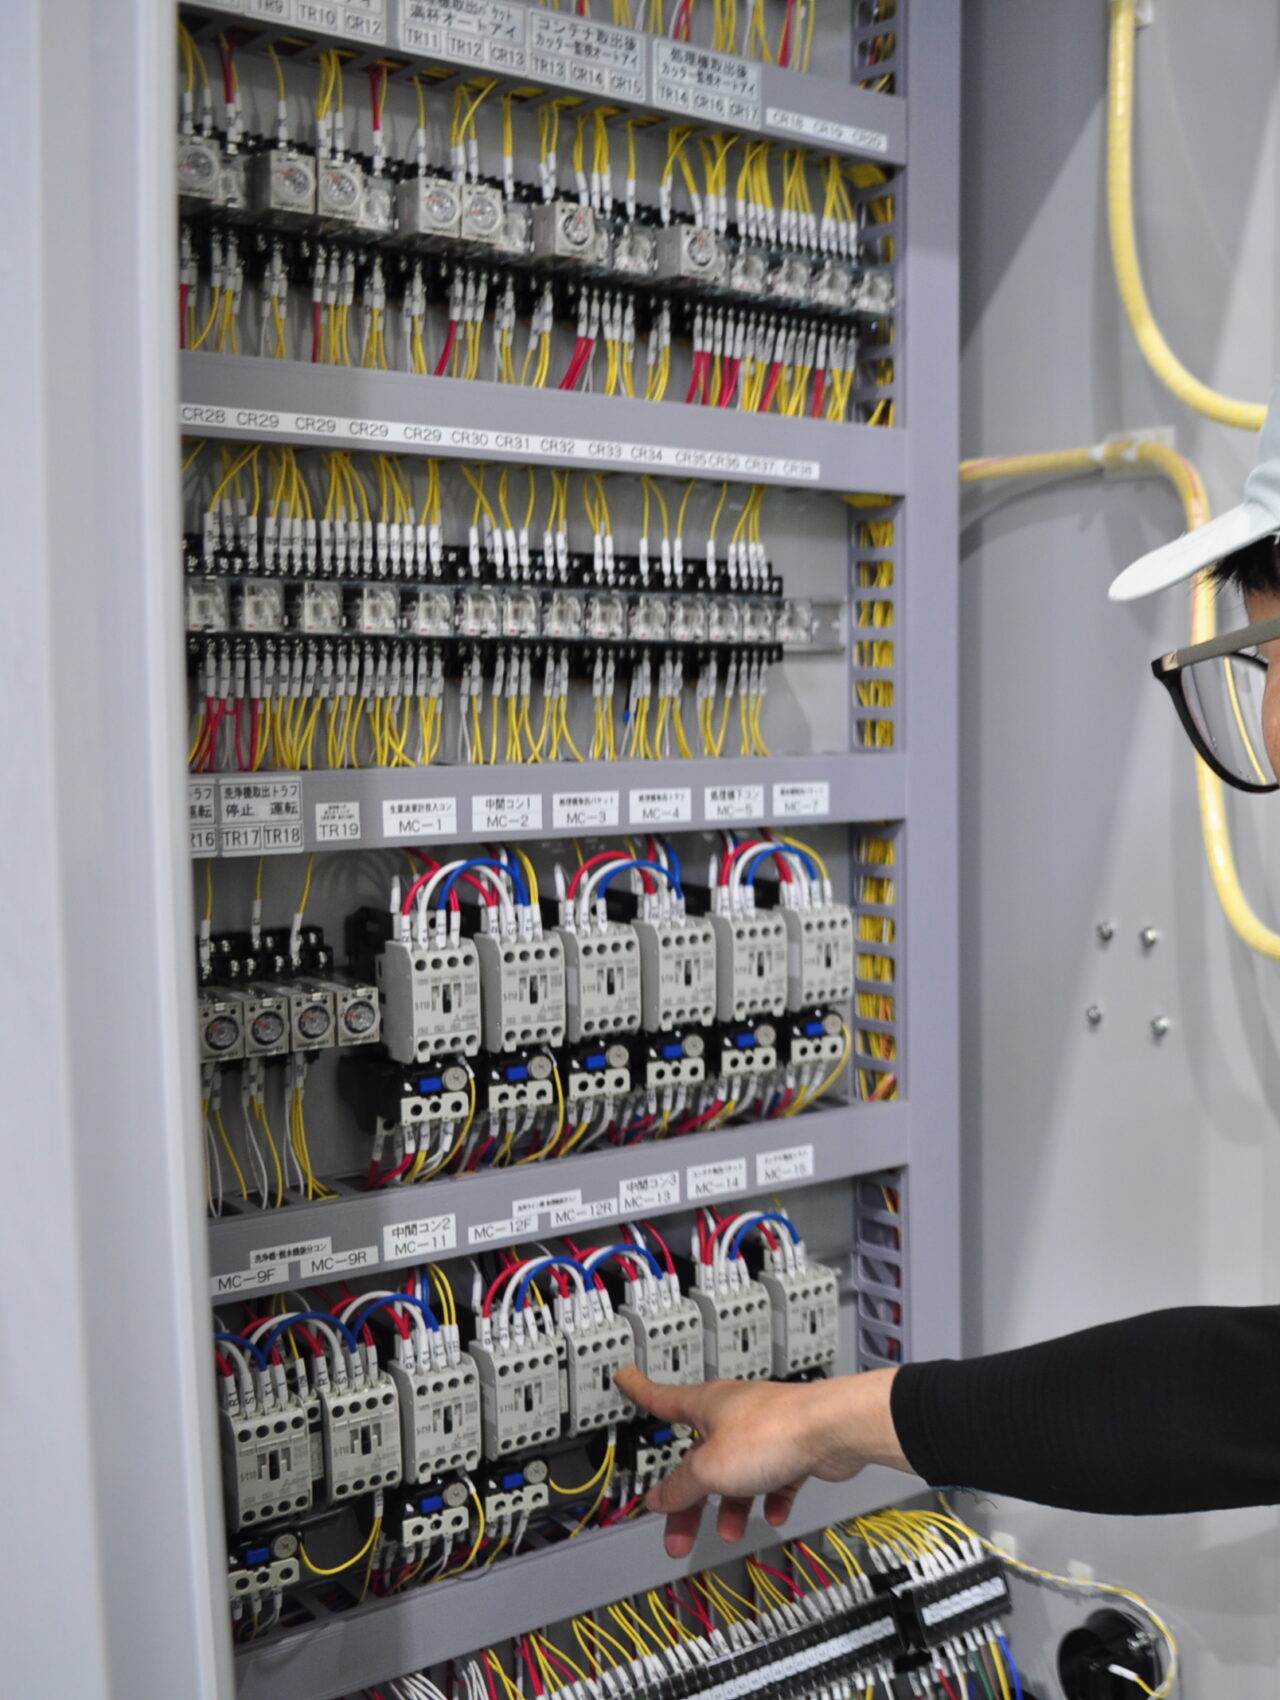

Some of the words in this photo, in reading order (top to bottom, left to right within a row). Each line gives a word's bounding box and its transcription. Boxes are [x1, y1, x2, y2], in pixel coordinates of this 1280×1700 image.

[298, 4, 336, 25] TR10
[346, 12, 382, 35] CR12
[405, 28, 438, 49] TR11
[451, 37, 482, 57] TR12
[491, 46, 524, 66] CR13
[534, 57, 565, 79] TR13
[572, 63, 604, 89] CR14
[660, 86, 688, 106] TR14
[182, 406, 226, 425] CR28
[235, 411, 280, 429] CR29
[294, 416, 338, 434] CR29
[348, 420, 389, 438] CR29
[403, 425, 442, 443] CR29
[450, 430, 489, 447] CR30
[494, 433, 530, 449] CR31
[540, 438, 576, 455] CR32
[588, 442, 622, 458] CR33
[630, 445, 663, 462] CR34
[744, 457, 776, 473] CR37
[224, 785, 298, 801] 洗浄機取出トラフ
[226, 803, 257, 818] 停止
[269, 801, 298, 816] 運転
[223, 829, 260, 847] TR17
[264, 826, 300, 845] TR18
[318, 822, 358, 838] TR19
